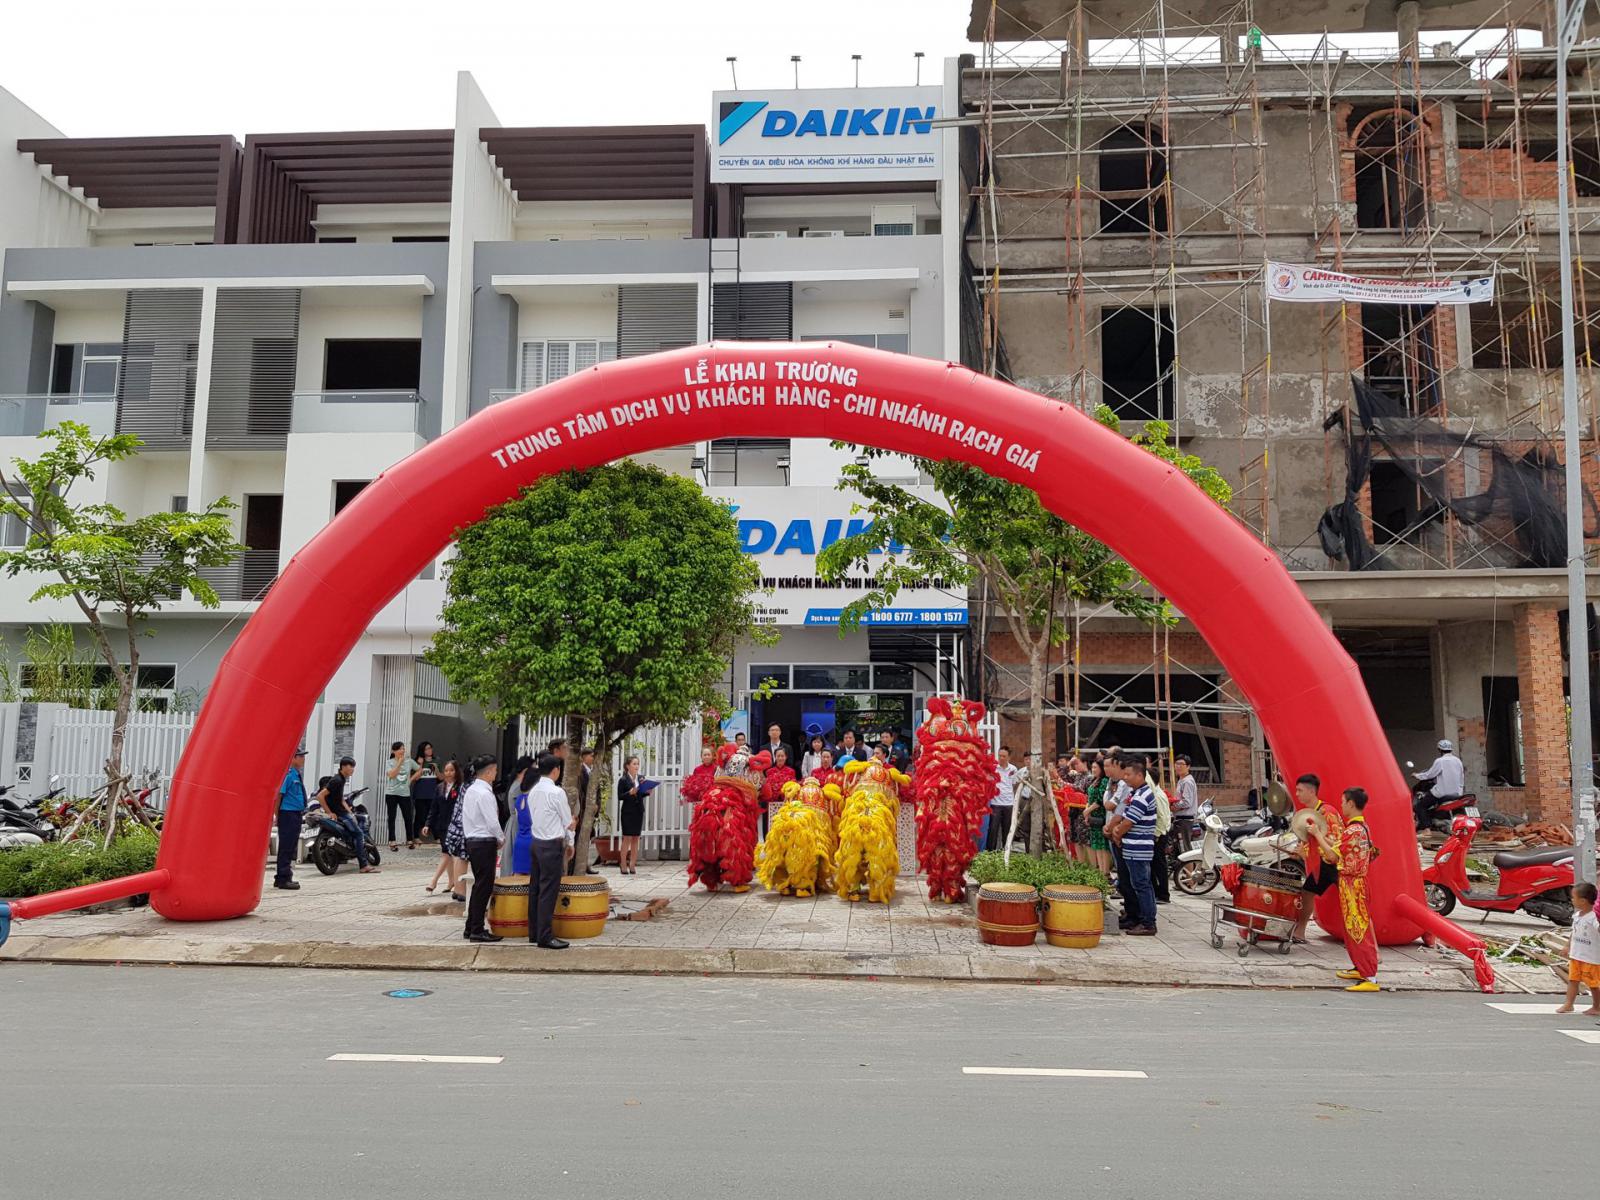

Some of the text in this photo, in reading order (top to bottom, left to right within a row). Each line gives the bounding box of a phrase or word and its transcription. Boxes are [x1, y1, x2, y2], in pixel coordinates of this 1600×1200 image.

[761, 107, 936, 137] DAIKIN
[719, 157, 750, 166] CHUYÊN
[807, 156, 835, 165] KHÔNG
[837, 156, 850, 165] KHÍ
[853, 156, 875, 165] HÀNG
[896, 156, 915, 166] NHẬT
[918, 155, 934, 164] BẢN
[684, 359, 858, 387] LỄ KHAI TRƯƠNG
[491, 427, 562, 469] TRUNG
[563, 413, 608, 441] TÂM
[611, 398, 659, 426] DỊCH
[661, 391, 691, 416] VỤ
[696, 383, 766, 409] KHÁCH
[775, 381, 831, 409] HÀNG
[843, 393, 876, 417] CHI
[880, 400, 946, 435] NHÁNH
[948, 419, 1003, 456] RẠCH
[1005, 443, 1043, 473] GIÁ
[778, 574, 812, 589] KHÁCH
[844, 577, 862, 589] CHI
[870, 612, 892, 623] 1800
[894, 612, 913, 623] 6777
[920, 612, 941, 623] 1800
[943, 612, 963, 623] 1577
